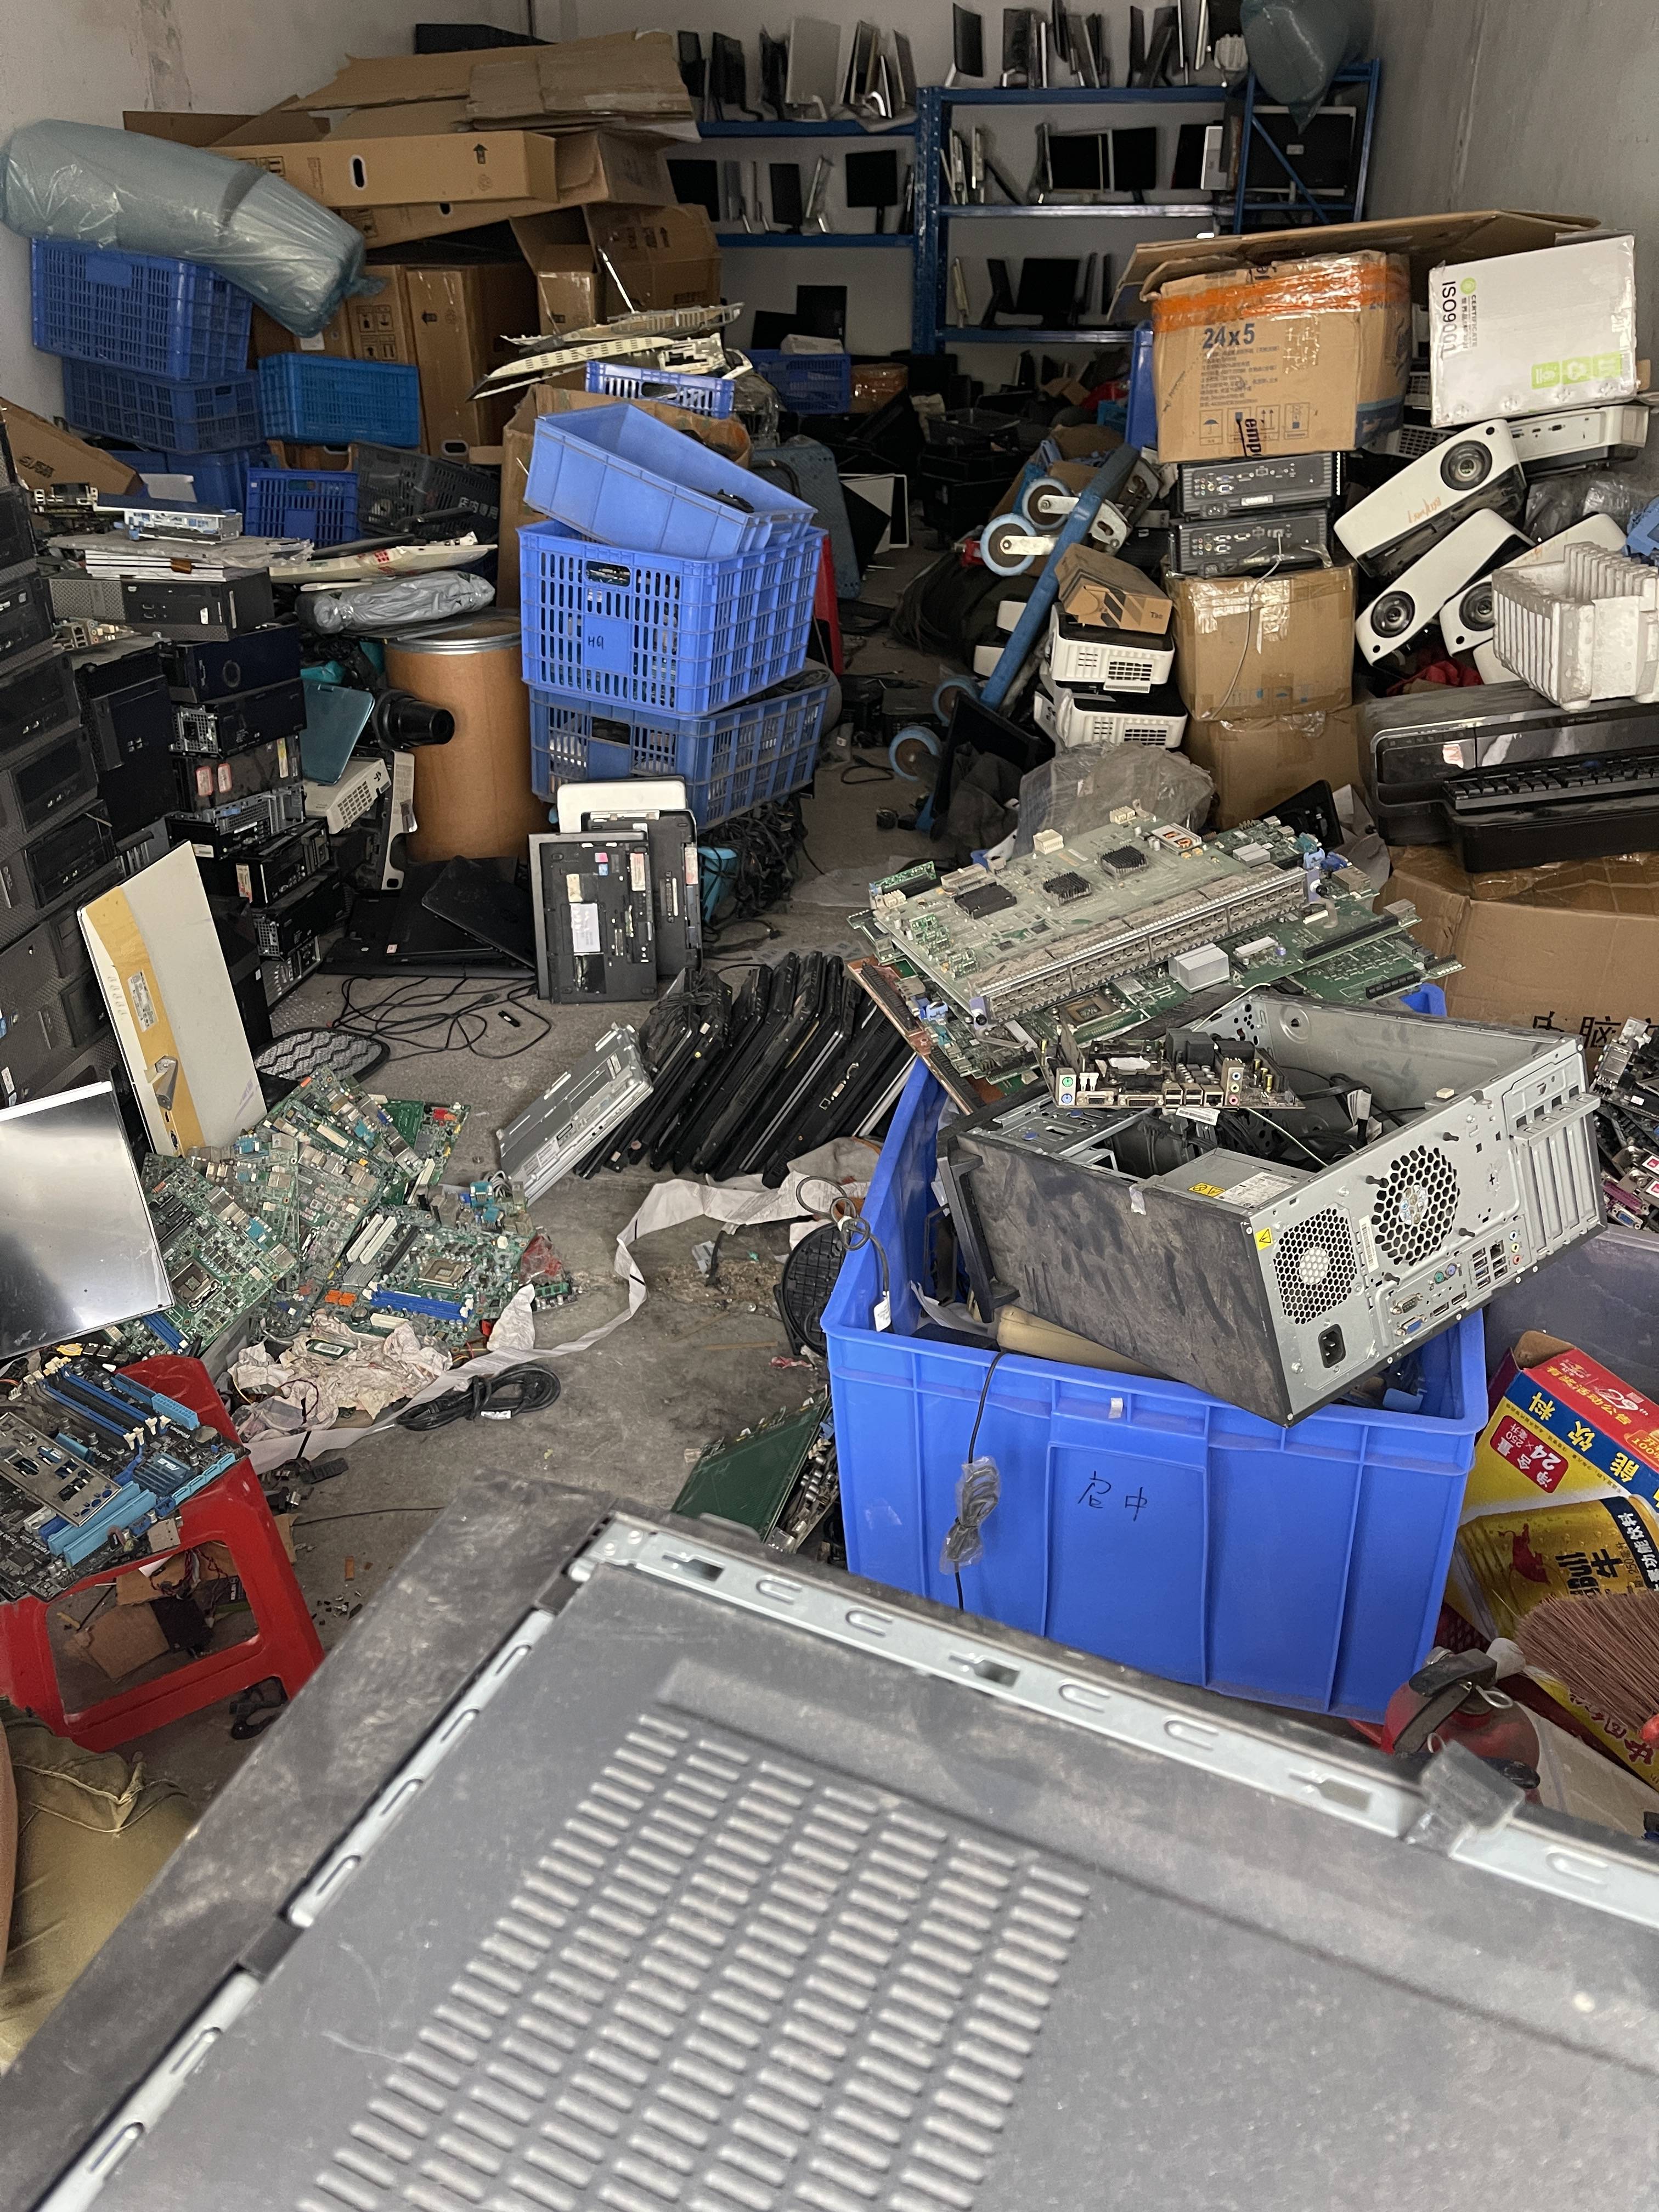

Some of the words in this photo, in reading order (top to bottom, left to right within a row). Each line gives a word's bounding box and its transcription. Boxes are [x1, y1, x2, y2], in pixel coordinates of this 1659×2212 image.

[1442, 280, 1457, 352] ISO9001
[1547, 1365, 1632, 1426] 有奖活动公告
[1497, 1436, 1553, 1488] 净含量
